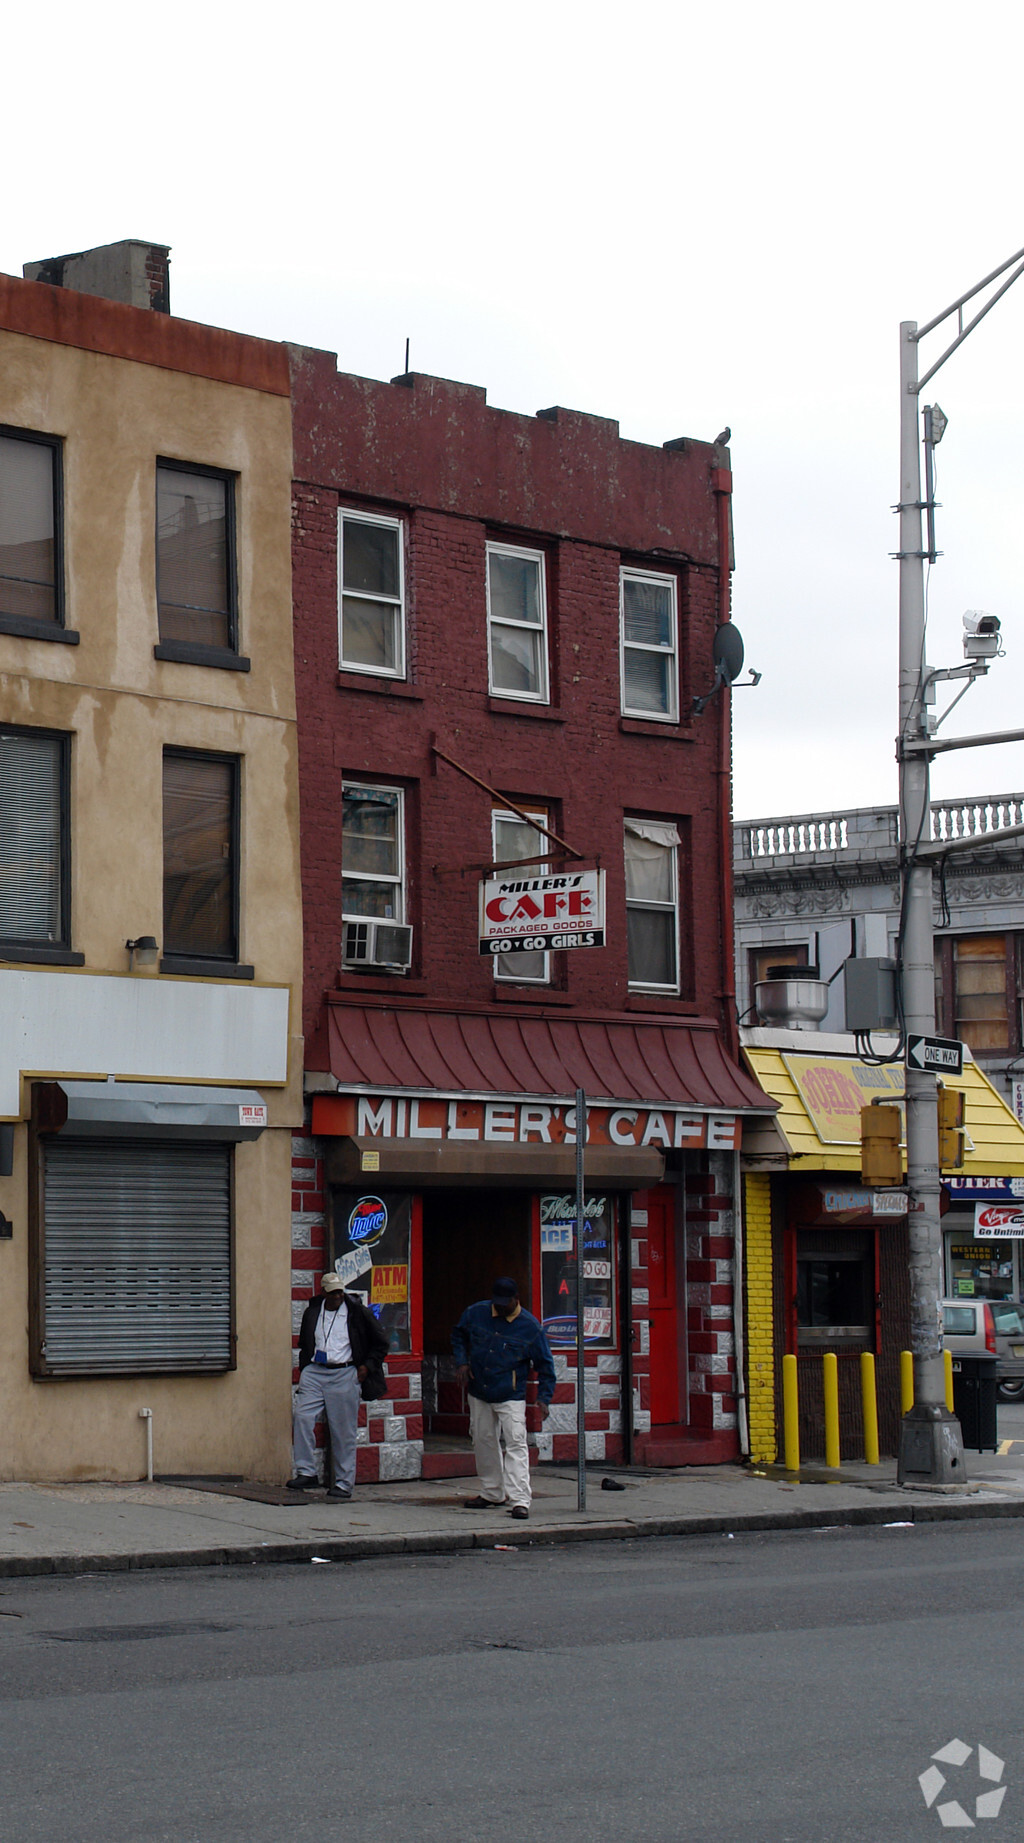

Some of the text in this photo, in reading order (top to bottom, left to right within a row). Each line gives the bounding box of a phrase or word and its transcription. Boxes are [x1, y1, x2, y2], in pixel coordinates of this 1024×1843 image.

[499, 875, 584, 894] MILLER'S
[486, 890, 592, 923] CAFE
[489, 920, 593, 935] PACKAGED GOODS
[489, 933, 595, 953] GO GO GIRLS
[924, 1047, 958, 1064] ONE WAY
[356, 1097, 736, 1150] MILLER'S CAFE
[978, 1228, 1024, 1236] Go Unlimi
[373, 1266, 407, 1287] ATM
[594, 1262, 608, 1276] GO
